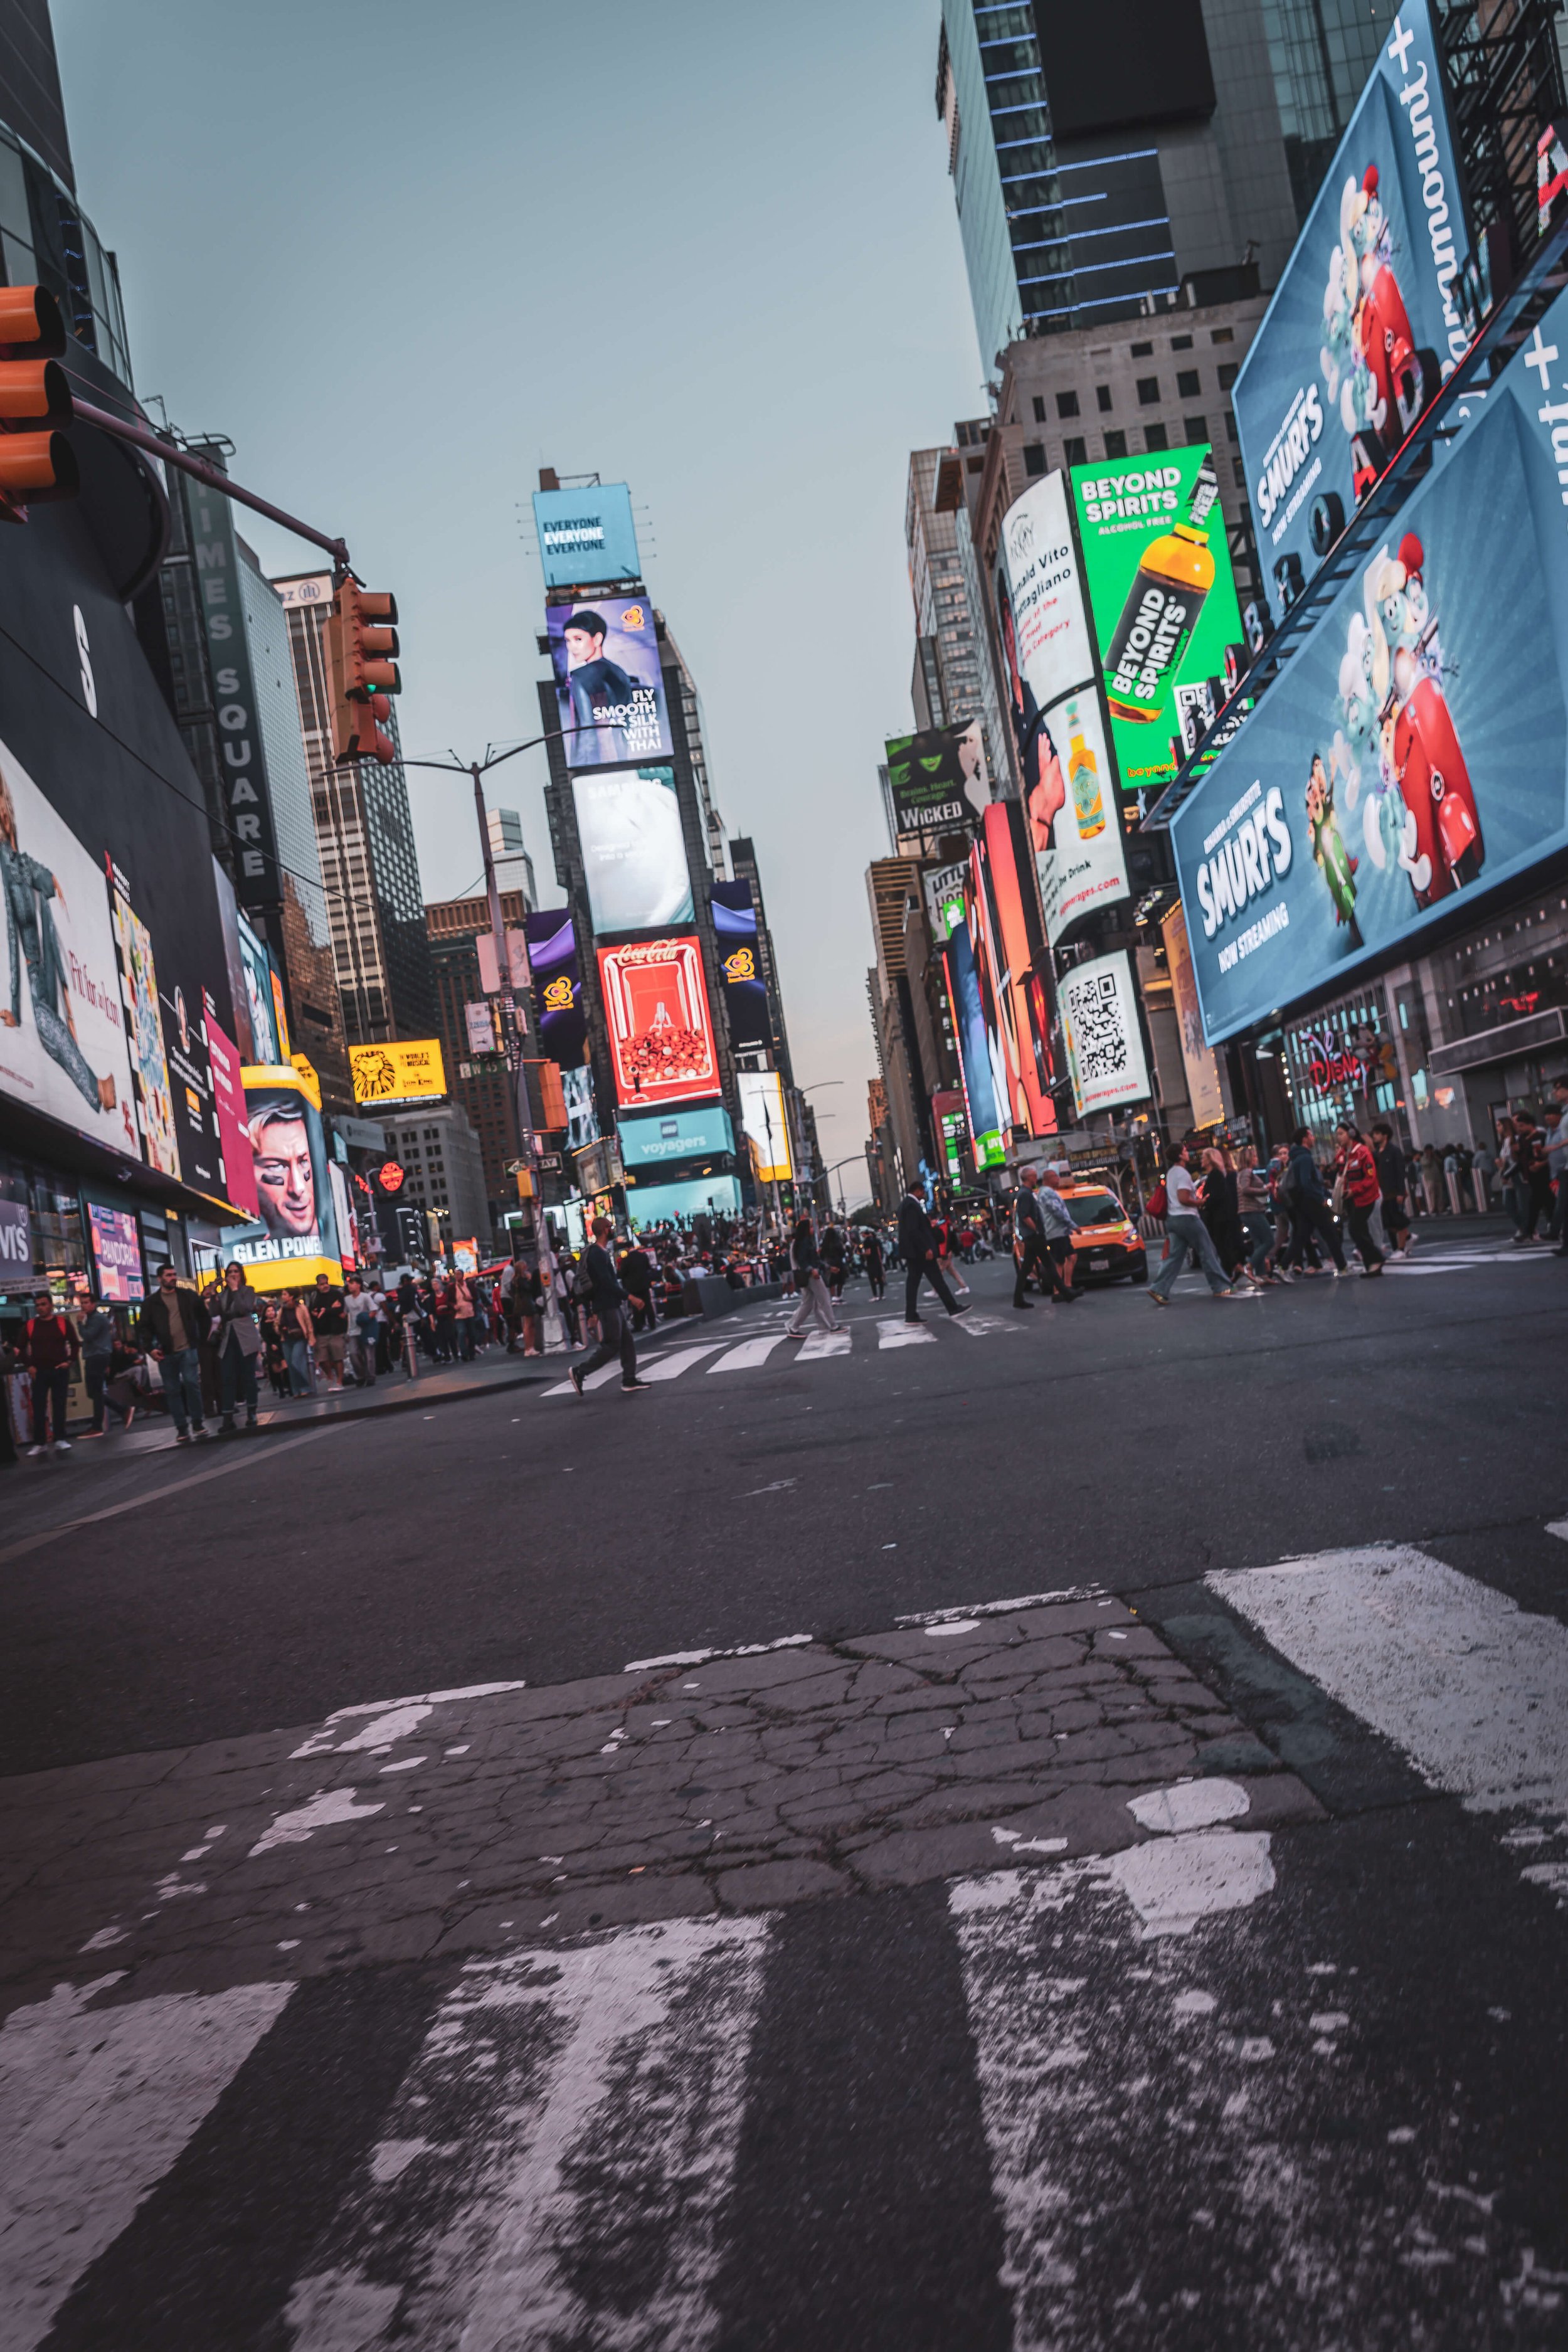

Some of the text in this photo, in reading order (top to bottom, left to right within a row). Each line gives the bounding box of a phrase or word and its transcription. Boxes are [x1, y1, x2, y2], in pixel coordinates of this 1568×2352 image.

[1258, 383, 1323, 527] SMURFS
[1081, 467, 1182, 502] BEYOND
[1085, 490, 1179, 523] SPIRITS
[543, 516, 601, 532] EVERYONE
[1098, 516, 1172, 536] ALCOHOL FREE
[544, 526, 605, 546] EVERYONE
[547, 539, 606, 556] EVERYONE
[196, 472, 233, 641] IMES
[1039, 546, 1069, 569] Vito
[1112, 588, 1165, 695] BEYOND
[632, 689, 654, 702] FLY
[593, 701, 657, 720] SMOOTH
[628, 713, 659, 728] SILK
[622, 725, 660, 741] WITH
[627, 738, 662, 753] THAI
[216, 667, 265, 878] SQUARE
[1197, 786, 1291, 938] SMURFS
[1218, 902, 1290, 973] NOW STREAMING
[485, 1064, 498, 1073] 45
[1300, 1030, 1370, 1100] Disney
[641, 1136, 707, 1155] voyagers
[100, 1238, 135, 1266] PANDORA
[232, 1239, 281, 1264] GLEN
